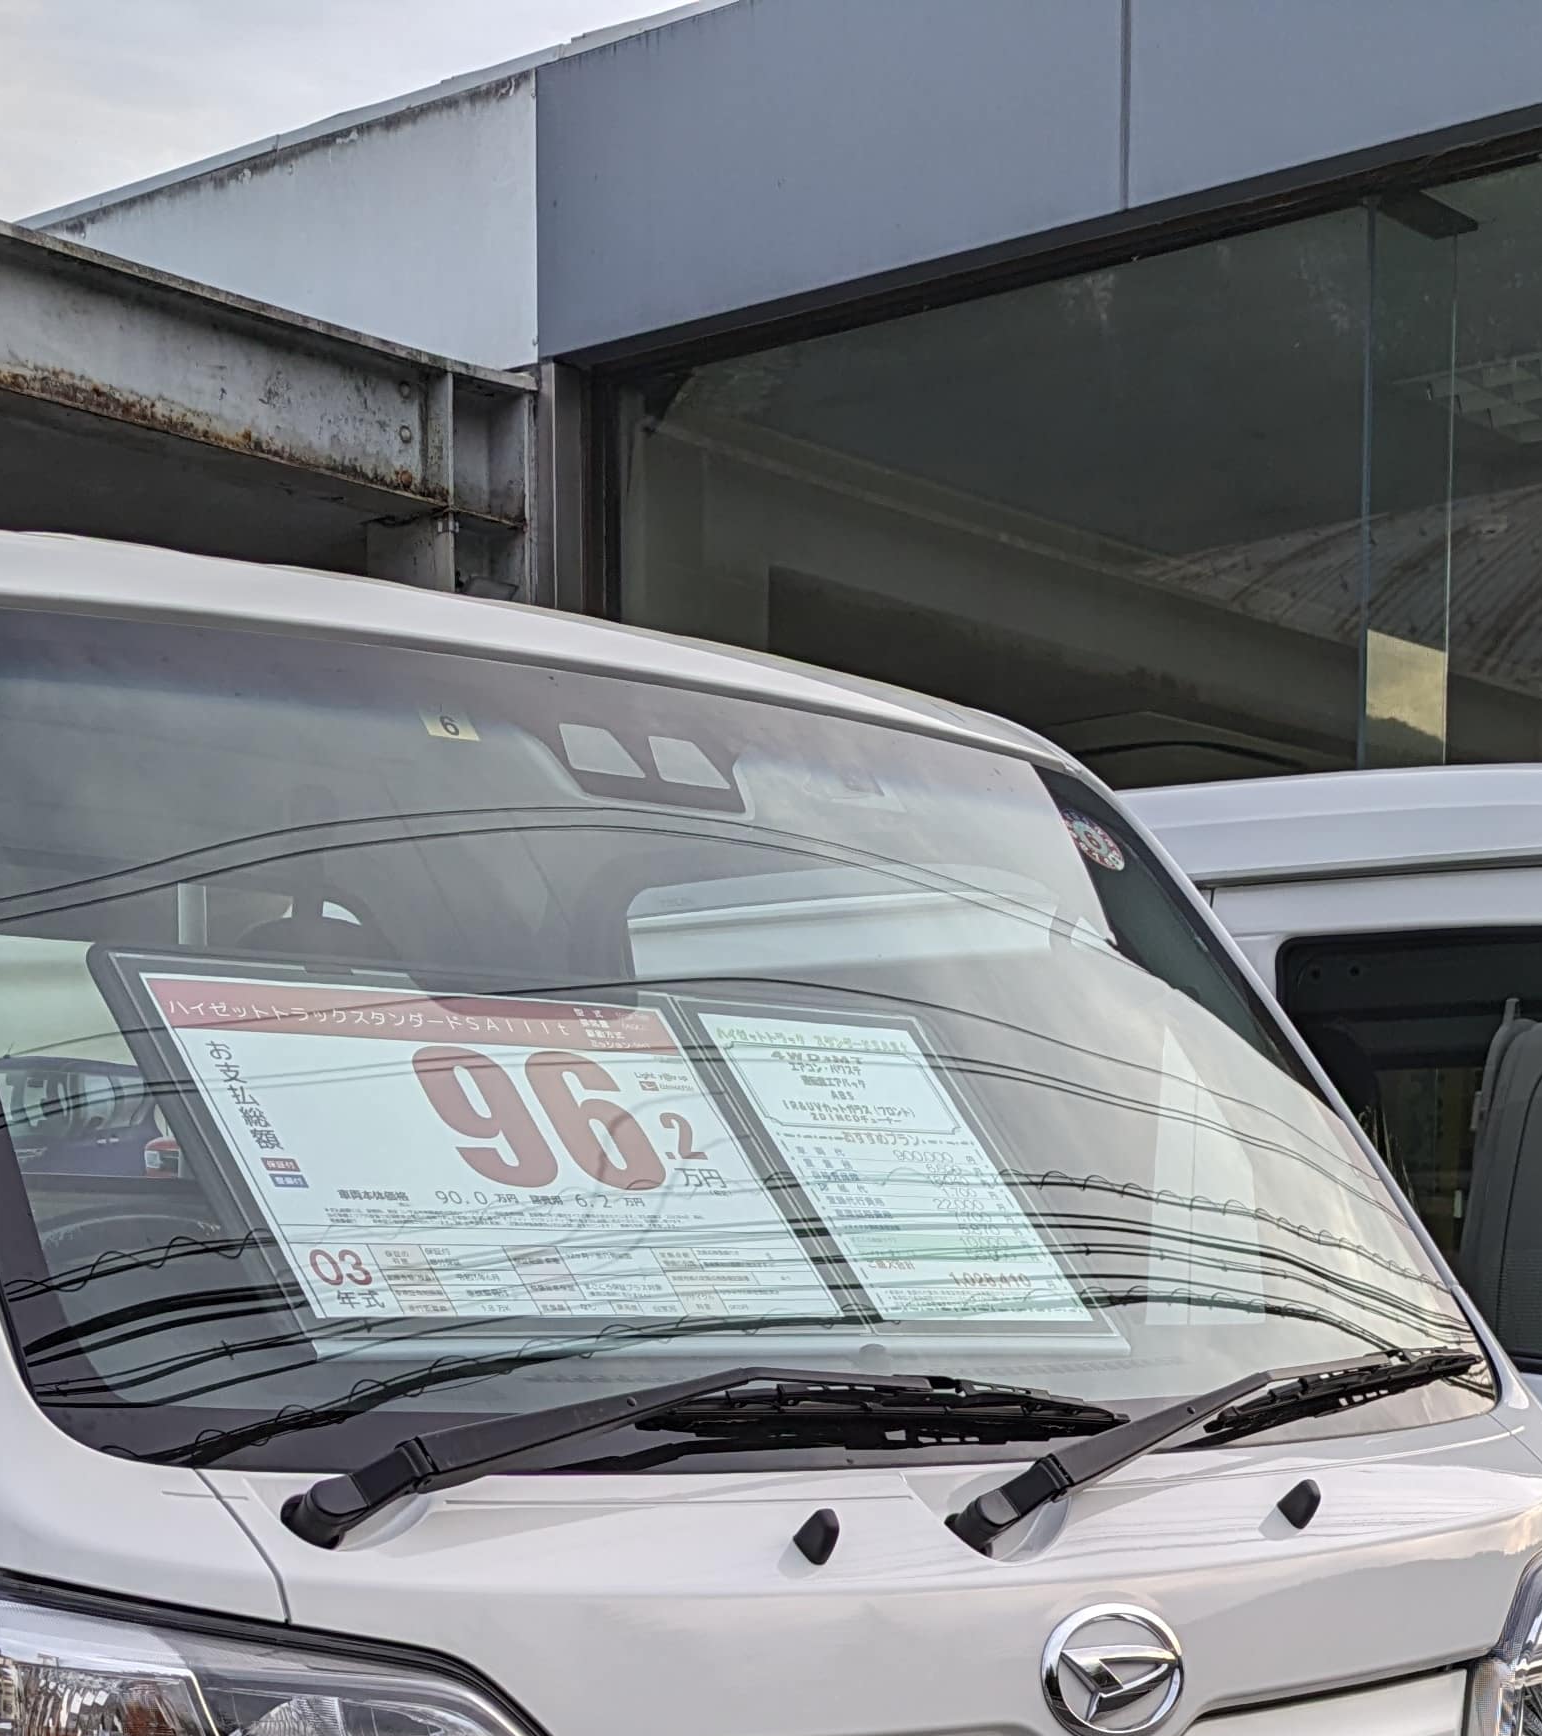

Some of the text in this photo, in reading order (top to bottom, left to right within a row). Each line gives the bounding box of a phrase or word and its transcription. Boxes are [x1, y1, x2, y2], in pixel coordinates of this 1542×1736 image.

[439, 715, 460, 736] 6
[205, 1040, 285, 1151] お支払総額
[674, 1167, 728, 1189] 万円
[309, 1249, 373, 1286] 03
[336, 1290, 385, 1309] 年式
